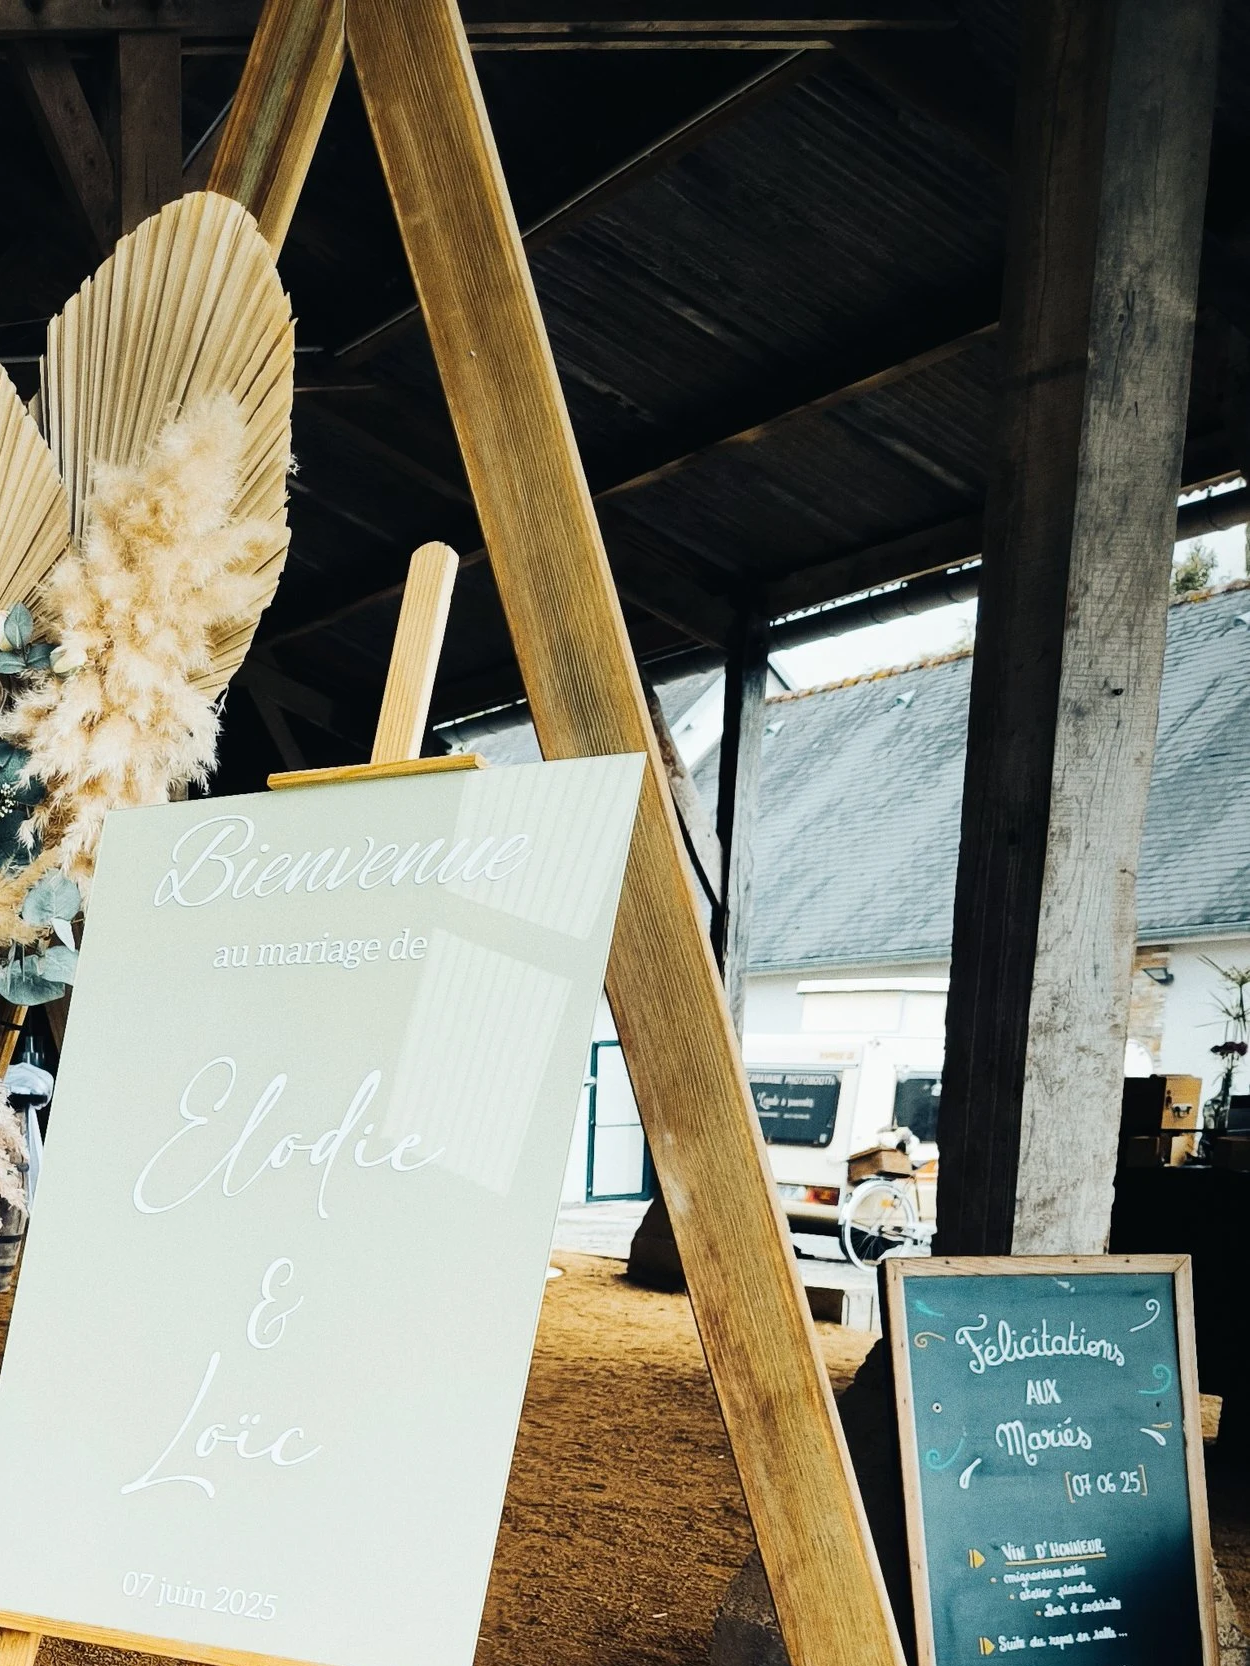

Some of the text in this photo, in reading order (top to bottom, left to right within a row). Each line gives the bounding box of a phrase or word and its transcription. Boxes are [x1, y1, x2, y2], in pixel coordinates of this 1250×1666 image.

[154, 814, 533, 908] Bienvenue
[213, 927, 428, 969] au mariage de
[133, 1056, 446, 1220] Elodie
[247, 1257, 304, 1350] &
[955, 1314, 1126, 1375] Félicitations
[1026, 1378, 1062, 1405] AUX
[121, 1351, 323, 1499] Loïc
[995, 1417, 1093, 1467] Mariés
[1096, 1472, 1117, 1494] 06
[122, 1571, 279, 1621] 07 juin 2025
[997, 1635, 1026, 1653] Suite
[1029, 1635, 1047, 1648] du
